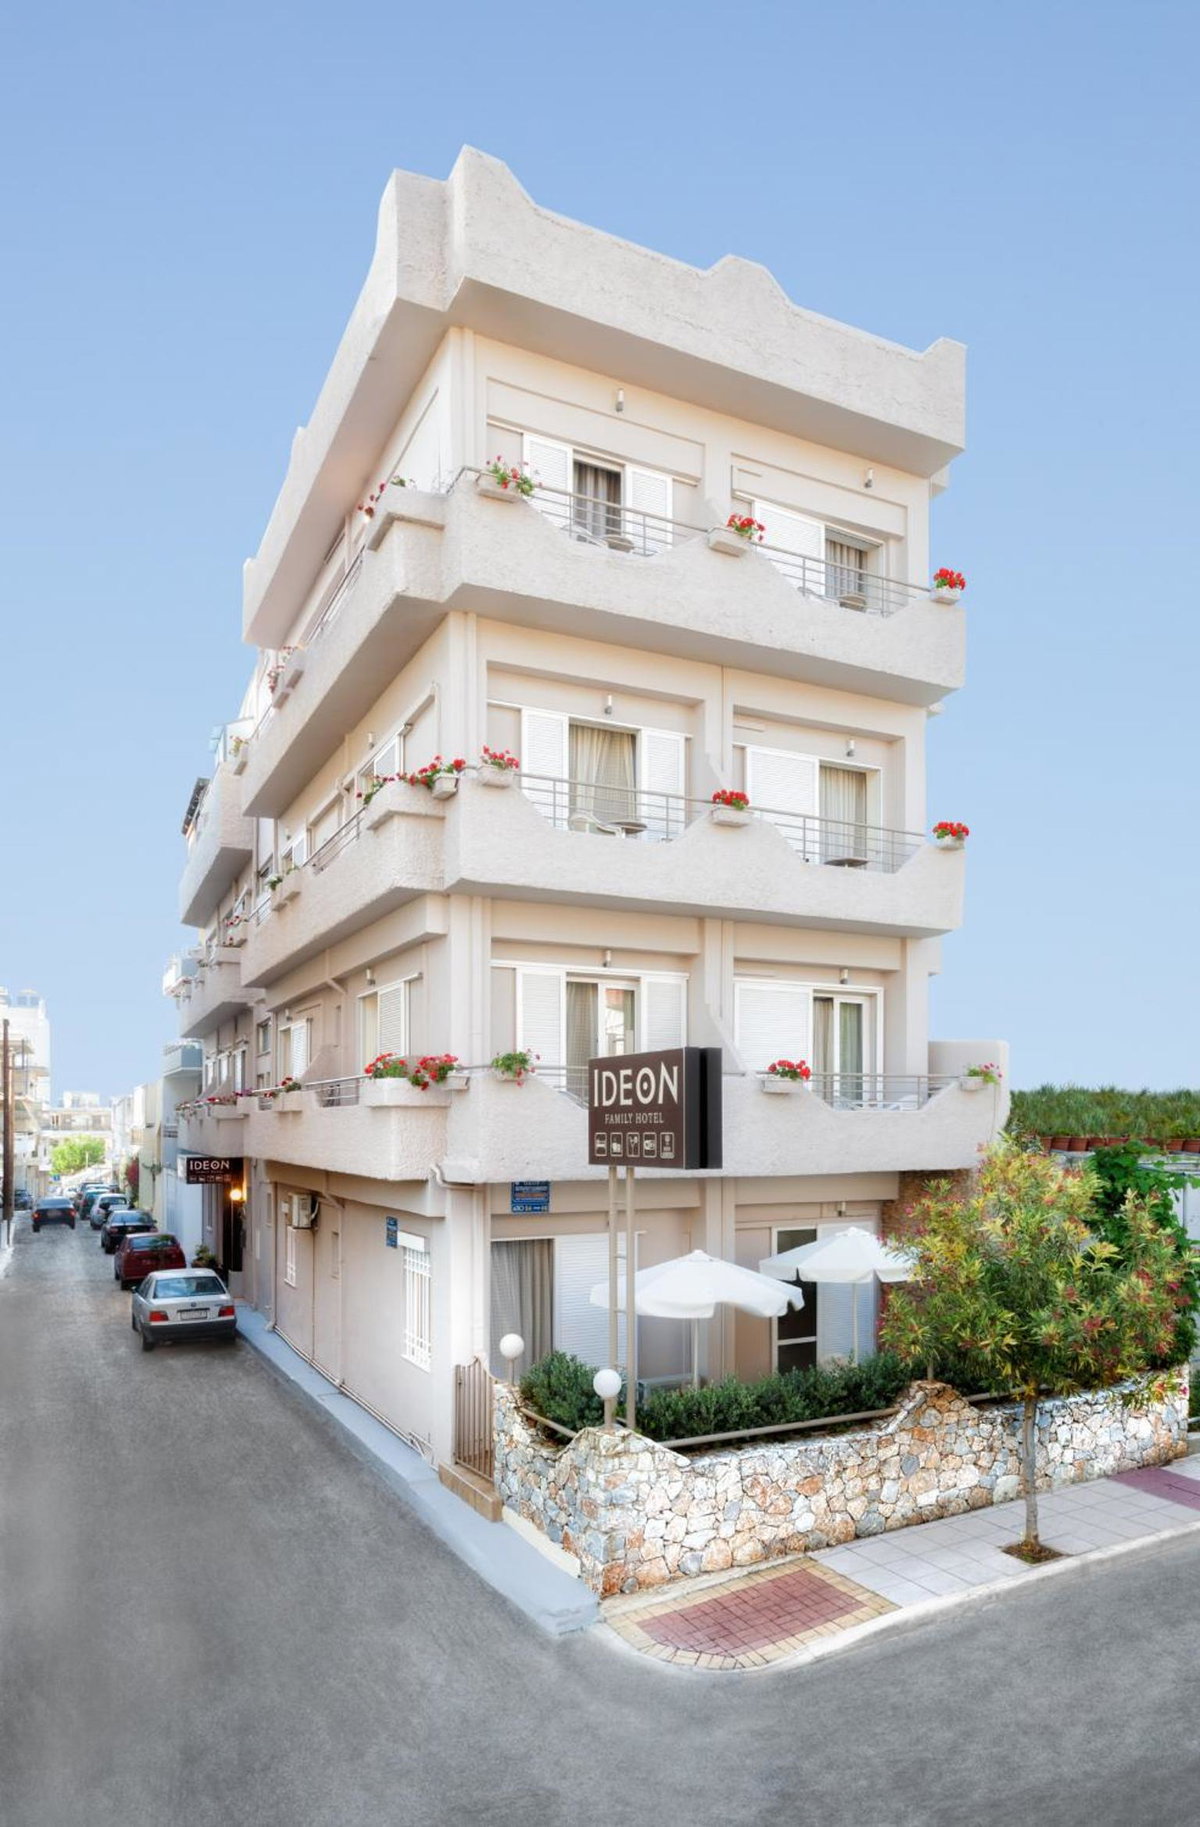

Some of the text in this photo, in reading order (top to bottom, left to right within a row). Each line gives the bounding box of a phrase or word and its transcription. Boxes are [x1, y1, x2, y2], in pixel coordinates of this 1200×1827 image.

[594, 1061, 678, 1107] IDEON
[604, 1112, 664, 1125] FAMILY HOTEL
[190, 1160, 229, 1170] IDEON
